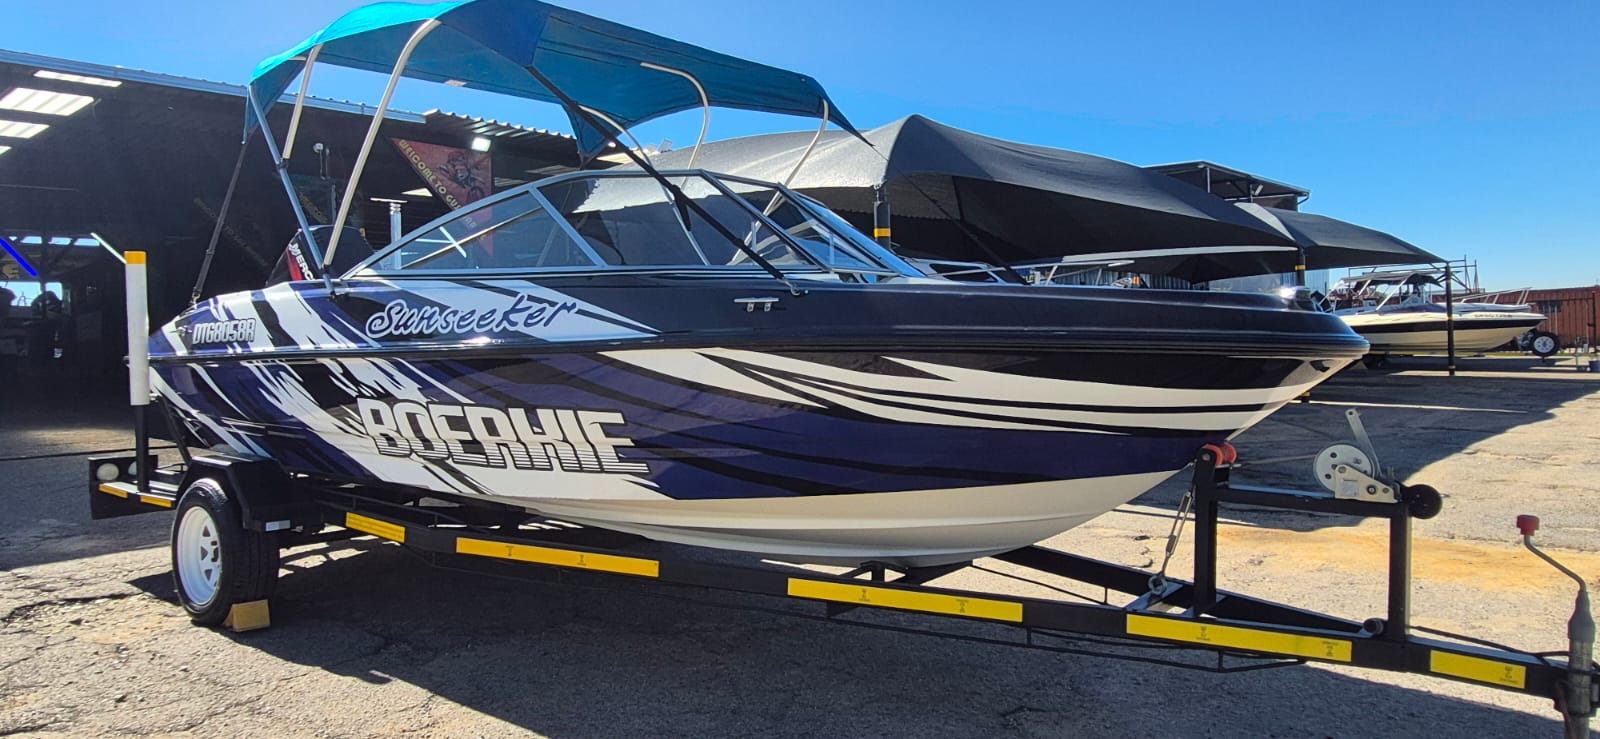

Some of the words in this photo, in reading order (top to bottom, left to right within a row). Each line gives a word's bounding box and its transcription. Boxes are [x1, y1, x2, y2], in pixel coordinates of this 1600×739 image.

[399, 139, 436, 183] WELCOME
[435, 180, 447, 195] TO
[192, 318, 256, 345] DTG8058R
[365, 292, 578, 339] Sunseeker
